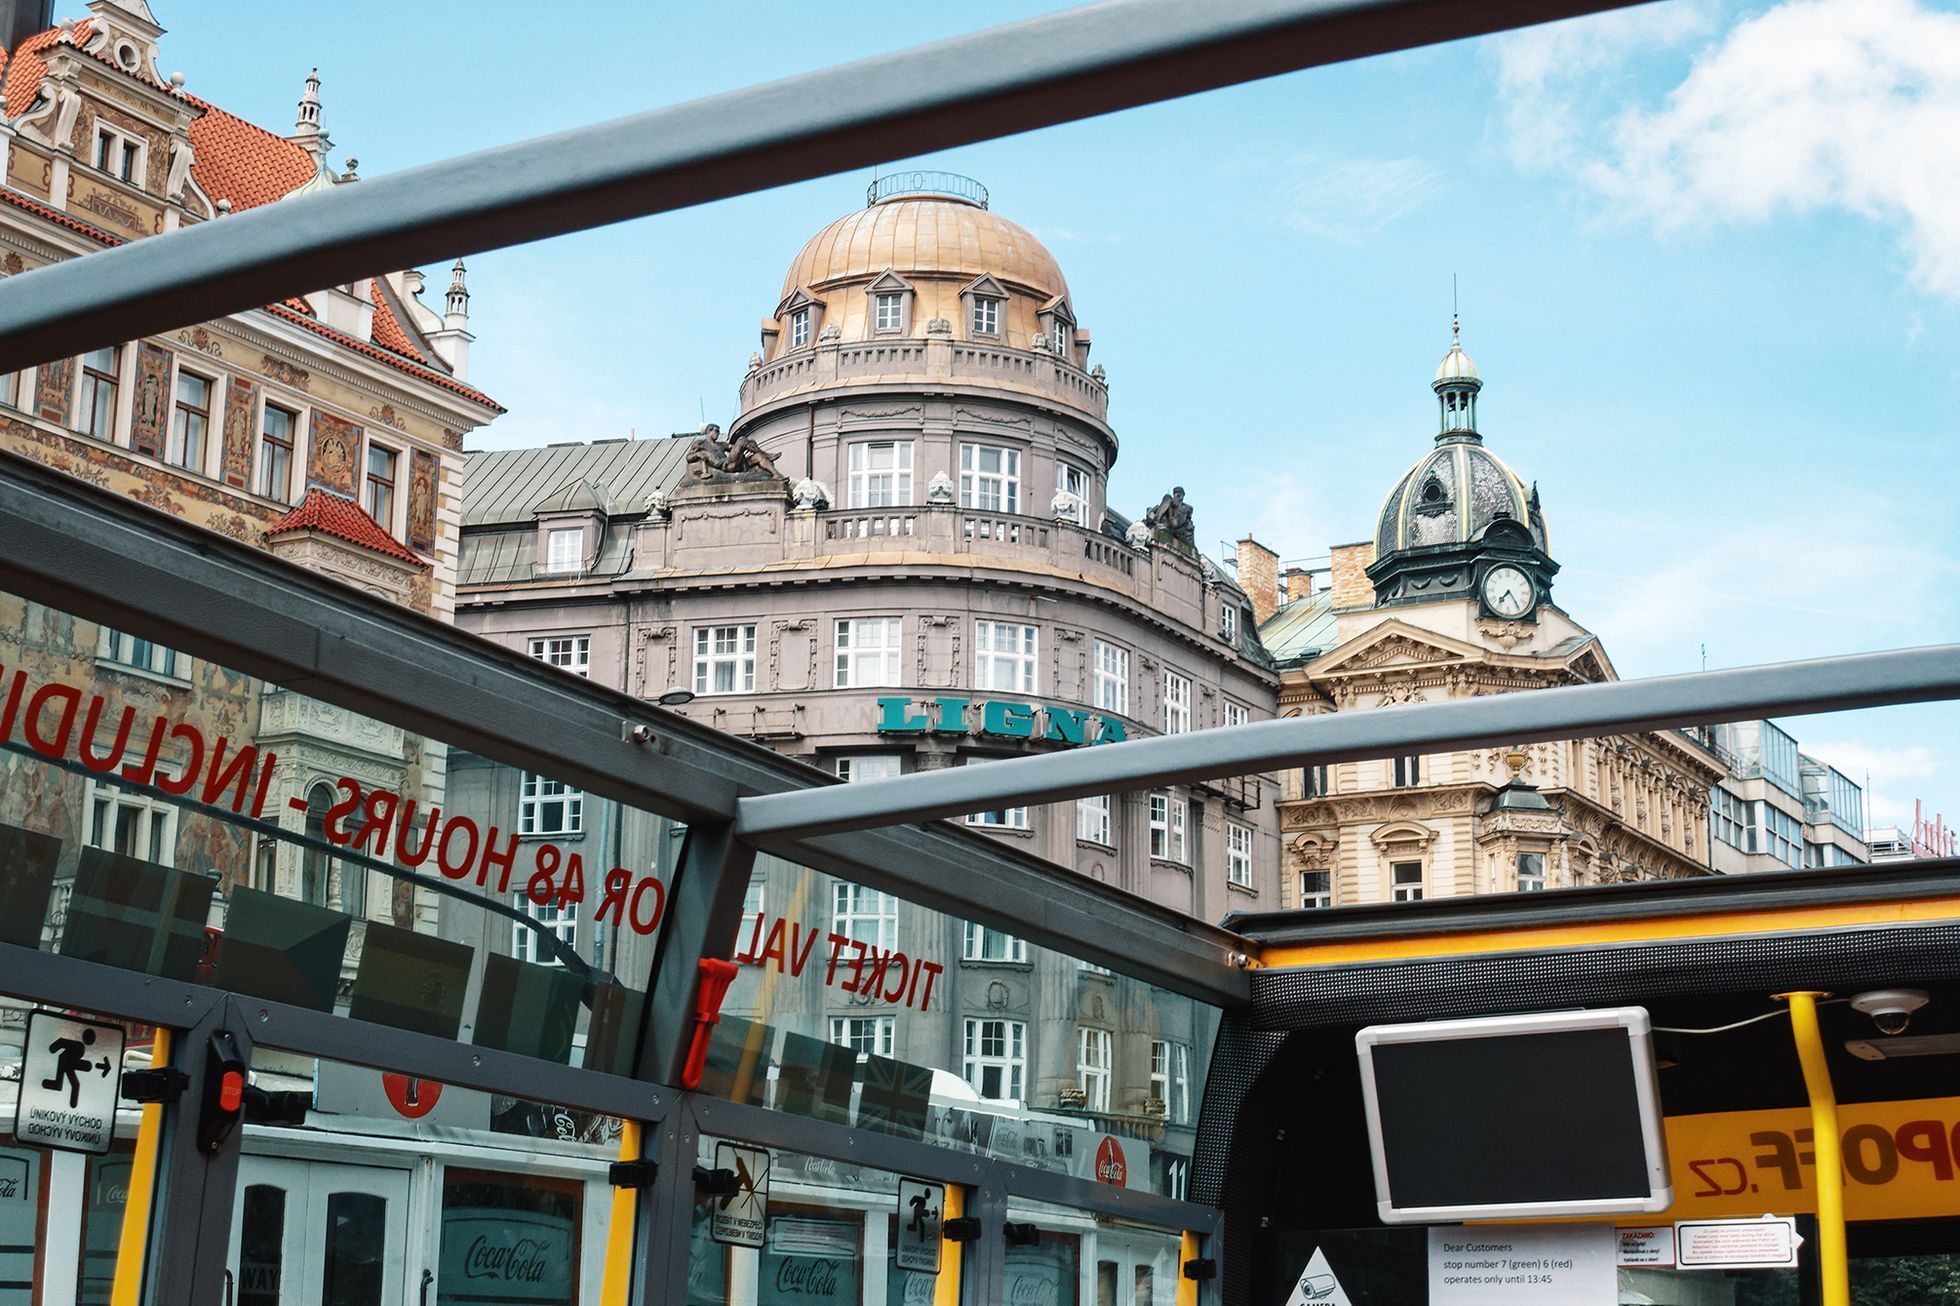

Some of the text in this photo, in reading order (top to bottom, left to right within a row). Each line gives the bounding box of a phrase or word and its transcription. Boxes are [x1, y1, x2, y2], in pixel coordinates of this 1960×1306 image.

[877, 697, 1128, 746] LIGNA
[69, 1112, 103, 1130] VÝCHOD
[1443, 1243, 1513, 1252] Dear Customers
[1443, 1259, 1573, 1270] stop number 7 (green) 6 (red)
[1444, 1274, 1552, 1285] operates only until 13:45
